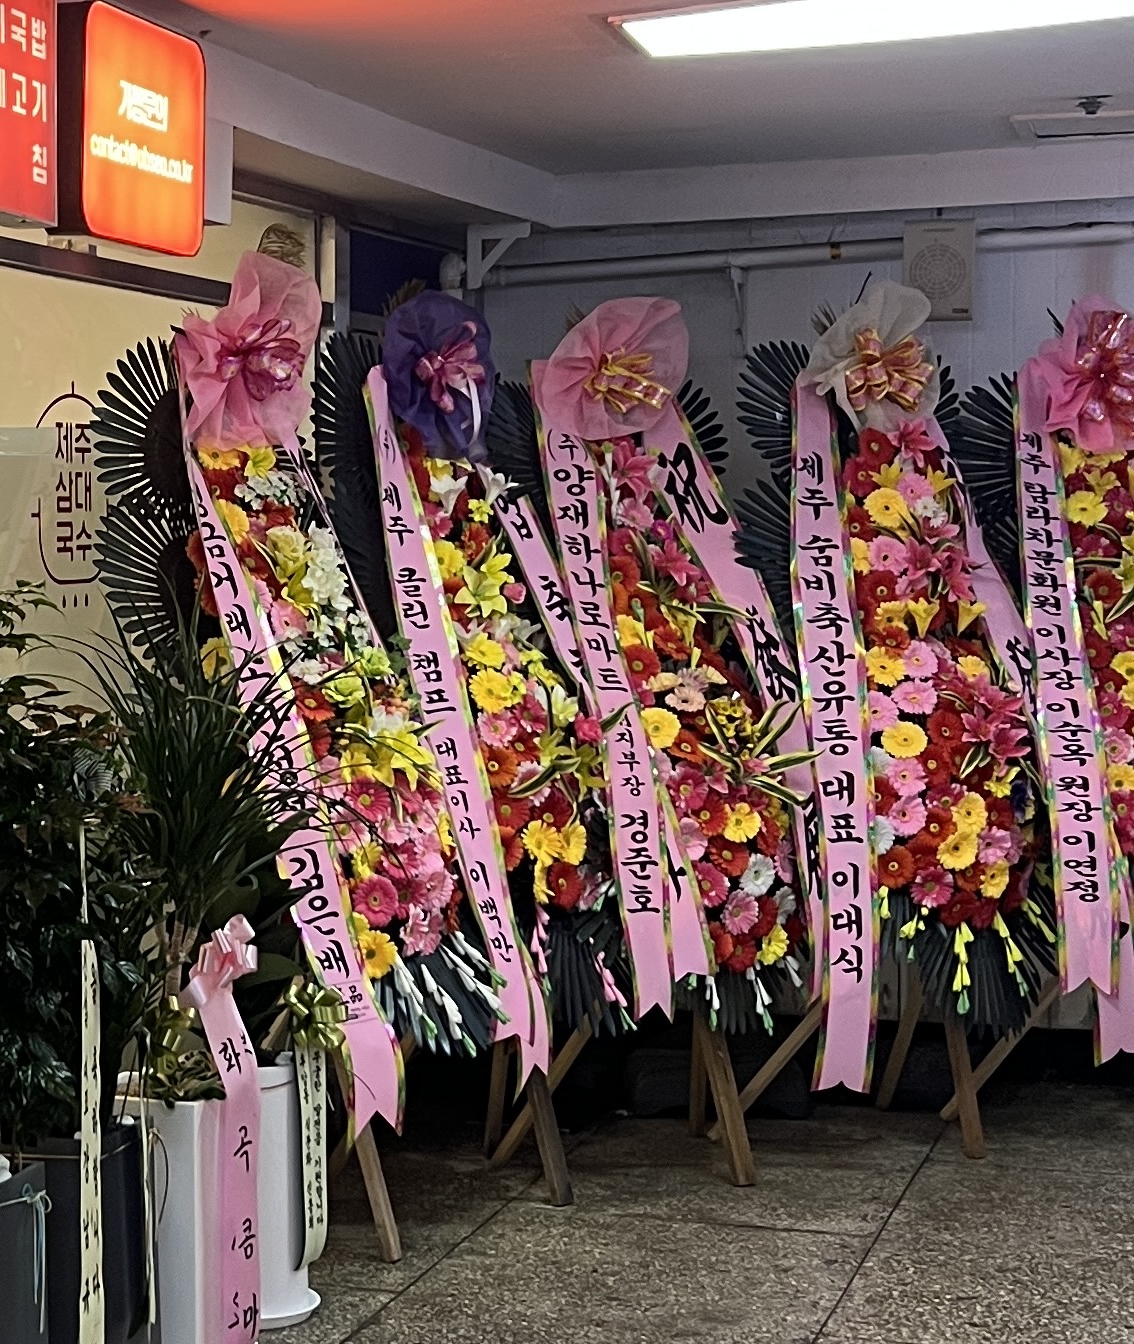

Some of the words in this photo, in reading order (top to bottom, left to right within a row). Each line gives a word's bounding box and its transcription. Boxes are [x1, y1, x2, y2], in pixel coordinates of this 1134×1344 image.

[54, 421, 92, 465] 제주
[1020, 431, 1052, 476] 제주
[55, 470, 92, 514] 삼대
[797, 450, 835, 522] 제주
[56, 519, 93, 562] 국수
[797, 533, 859, 758] 숨비축산유통
[1035, 622, 1084, 691] 이사장
[394, 566, 431, 631] 클린
[435, 736, 481, 840] 대표이사
[469, 860, 513, 963] 이백만
[1055, 773, 1103, 824] 원장
[819, 769, 864, 845] 대표
[620, 808, 661, 914] 경준호
[1061, 829, 1101, 904] 이연정
[288, 846, 350, 980] 김은배
[830, 861, 864, 985] 이대식
